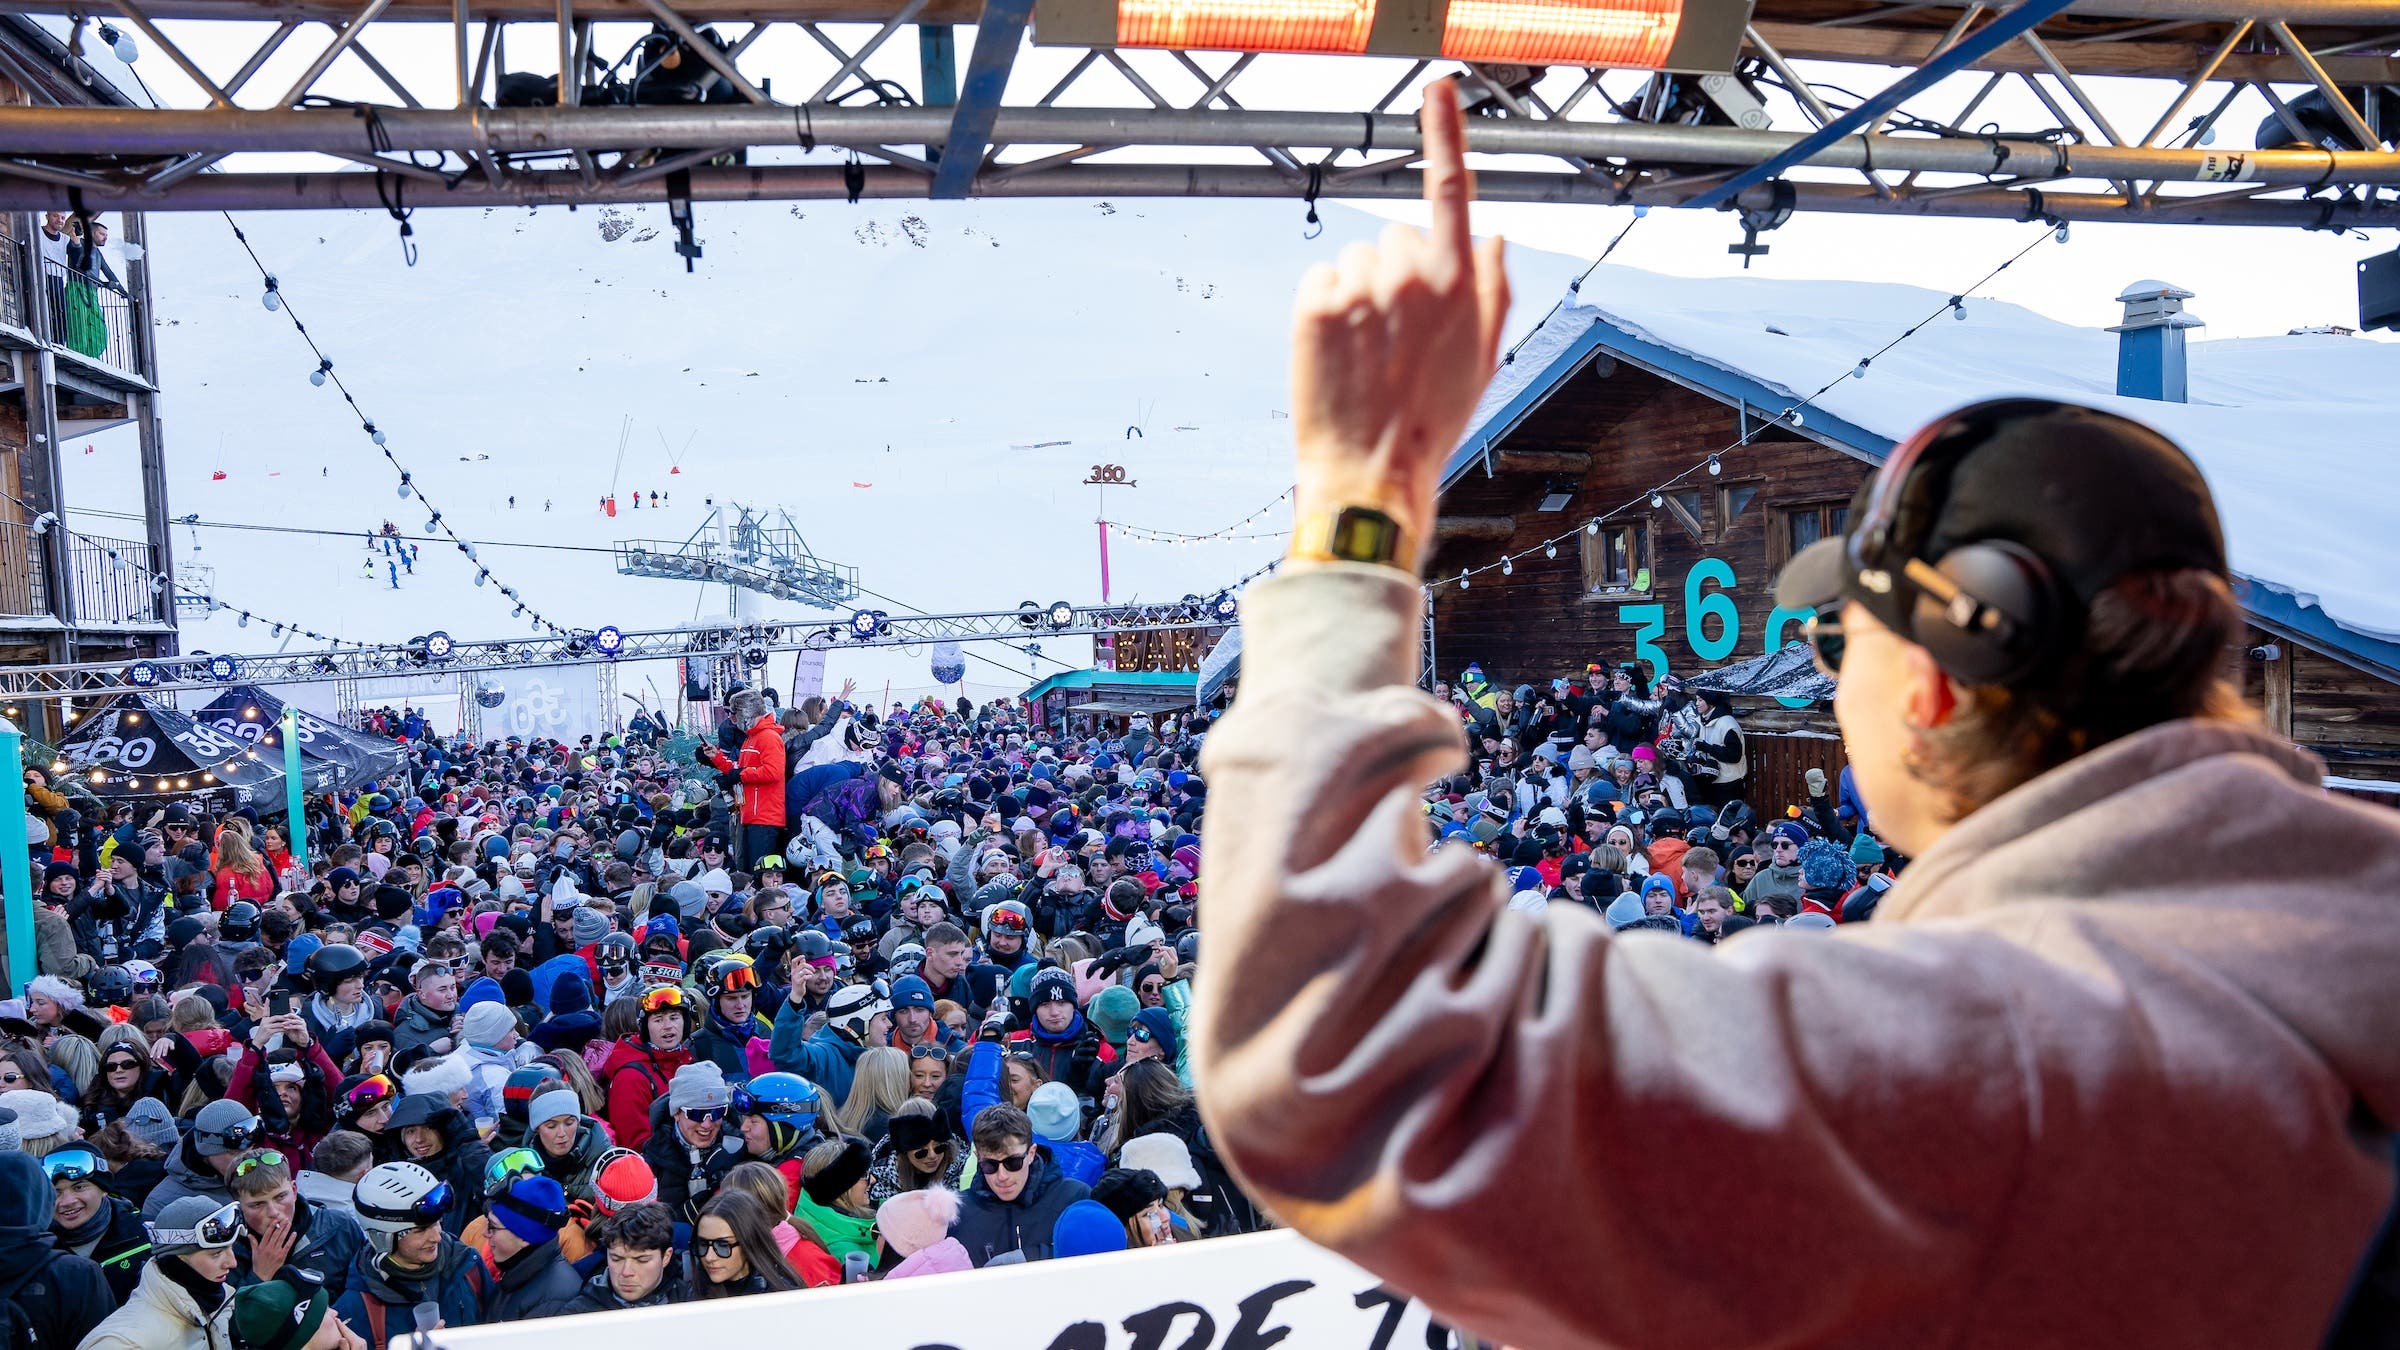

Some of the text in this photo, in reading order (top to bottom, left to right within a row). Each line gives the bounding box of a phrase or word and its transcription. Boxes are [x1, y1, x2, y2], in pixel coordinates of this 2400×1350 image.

[1090, 464, 1126, 483] 360
[1114, 617, 1200, 673] BAR
[1050, 985, 1064, 1001] NY
